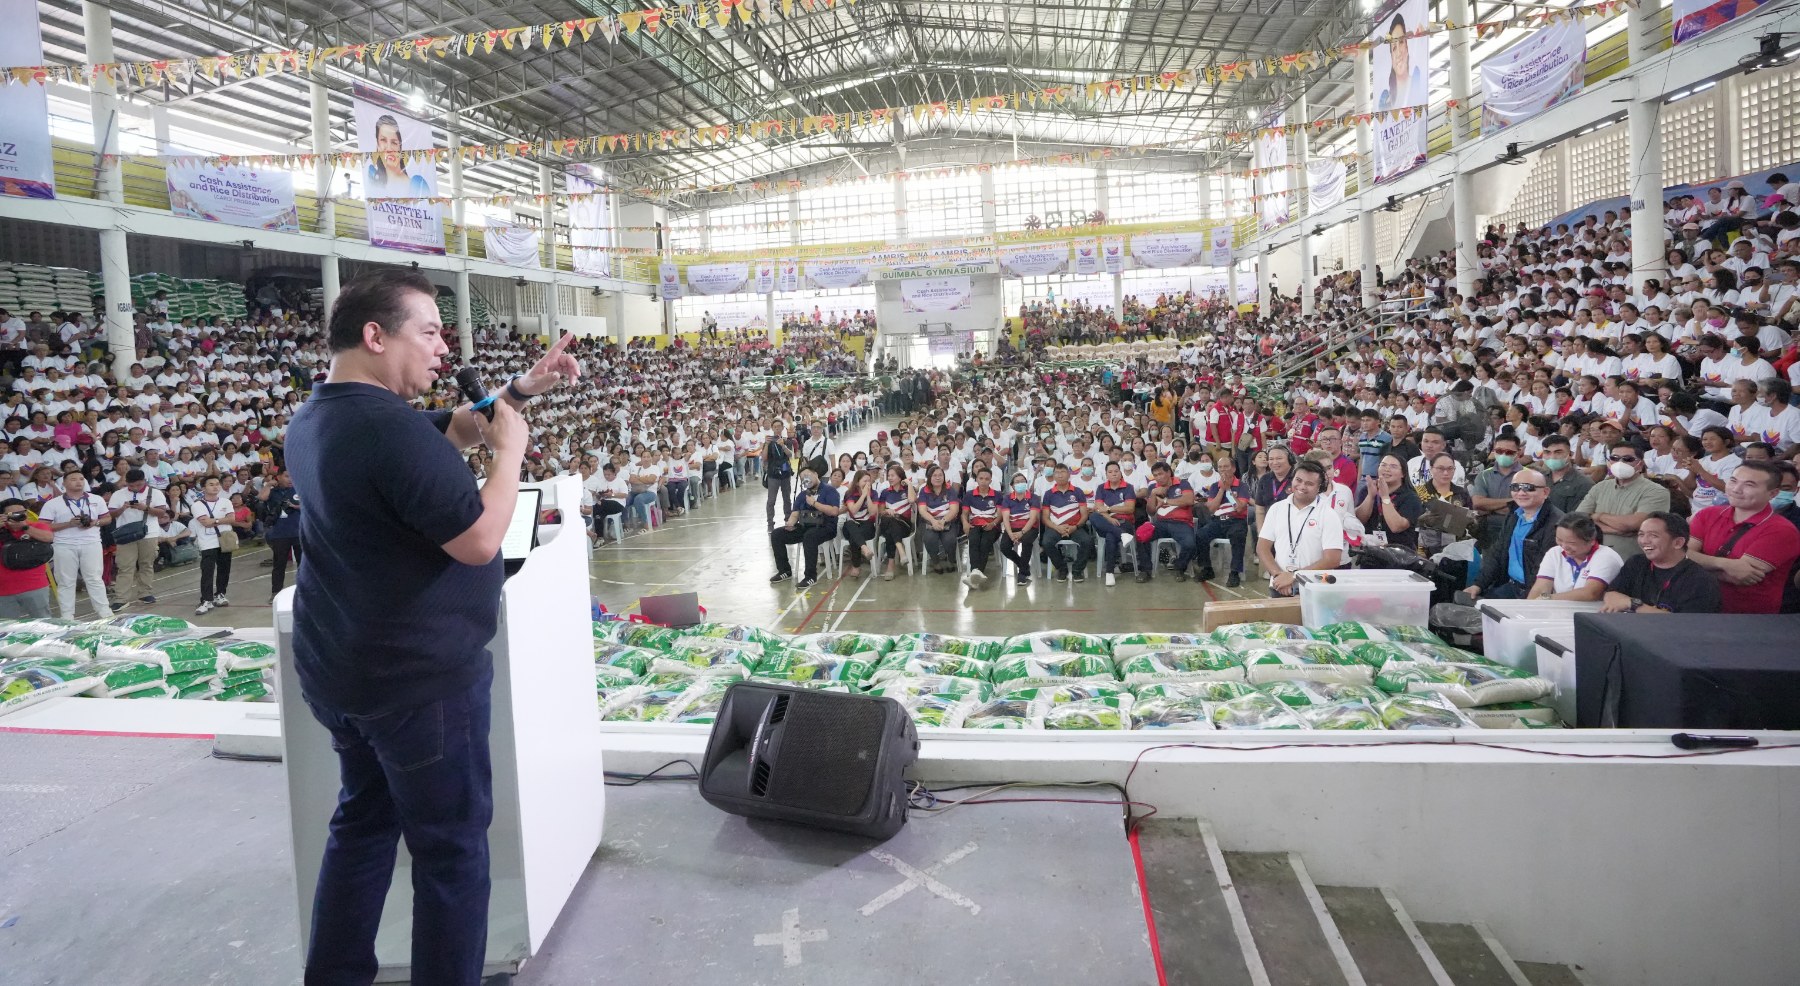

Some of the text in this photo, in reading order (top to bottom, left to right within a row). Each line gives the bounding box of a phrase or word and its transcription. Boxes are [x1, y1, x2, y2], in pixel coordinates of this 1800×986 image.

[1508, 78, 1523, 89] Rice
[1525, 54, 1569, 82] Distribution
[189, 182, 280, 204] and Rice Distribution
[199, 174, 272, 195] Cash Assistance
[373, 202, 434, 220] JANETTE L.
[387, 215, 422, 229] GARIN
[882, 266, 984, 279] GUIMBAL GYMNASIUM
